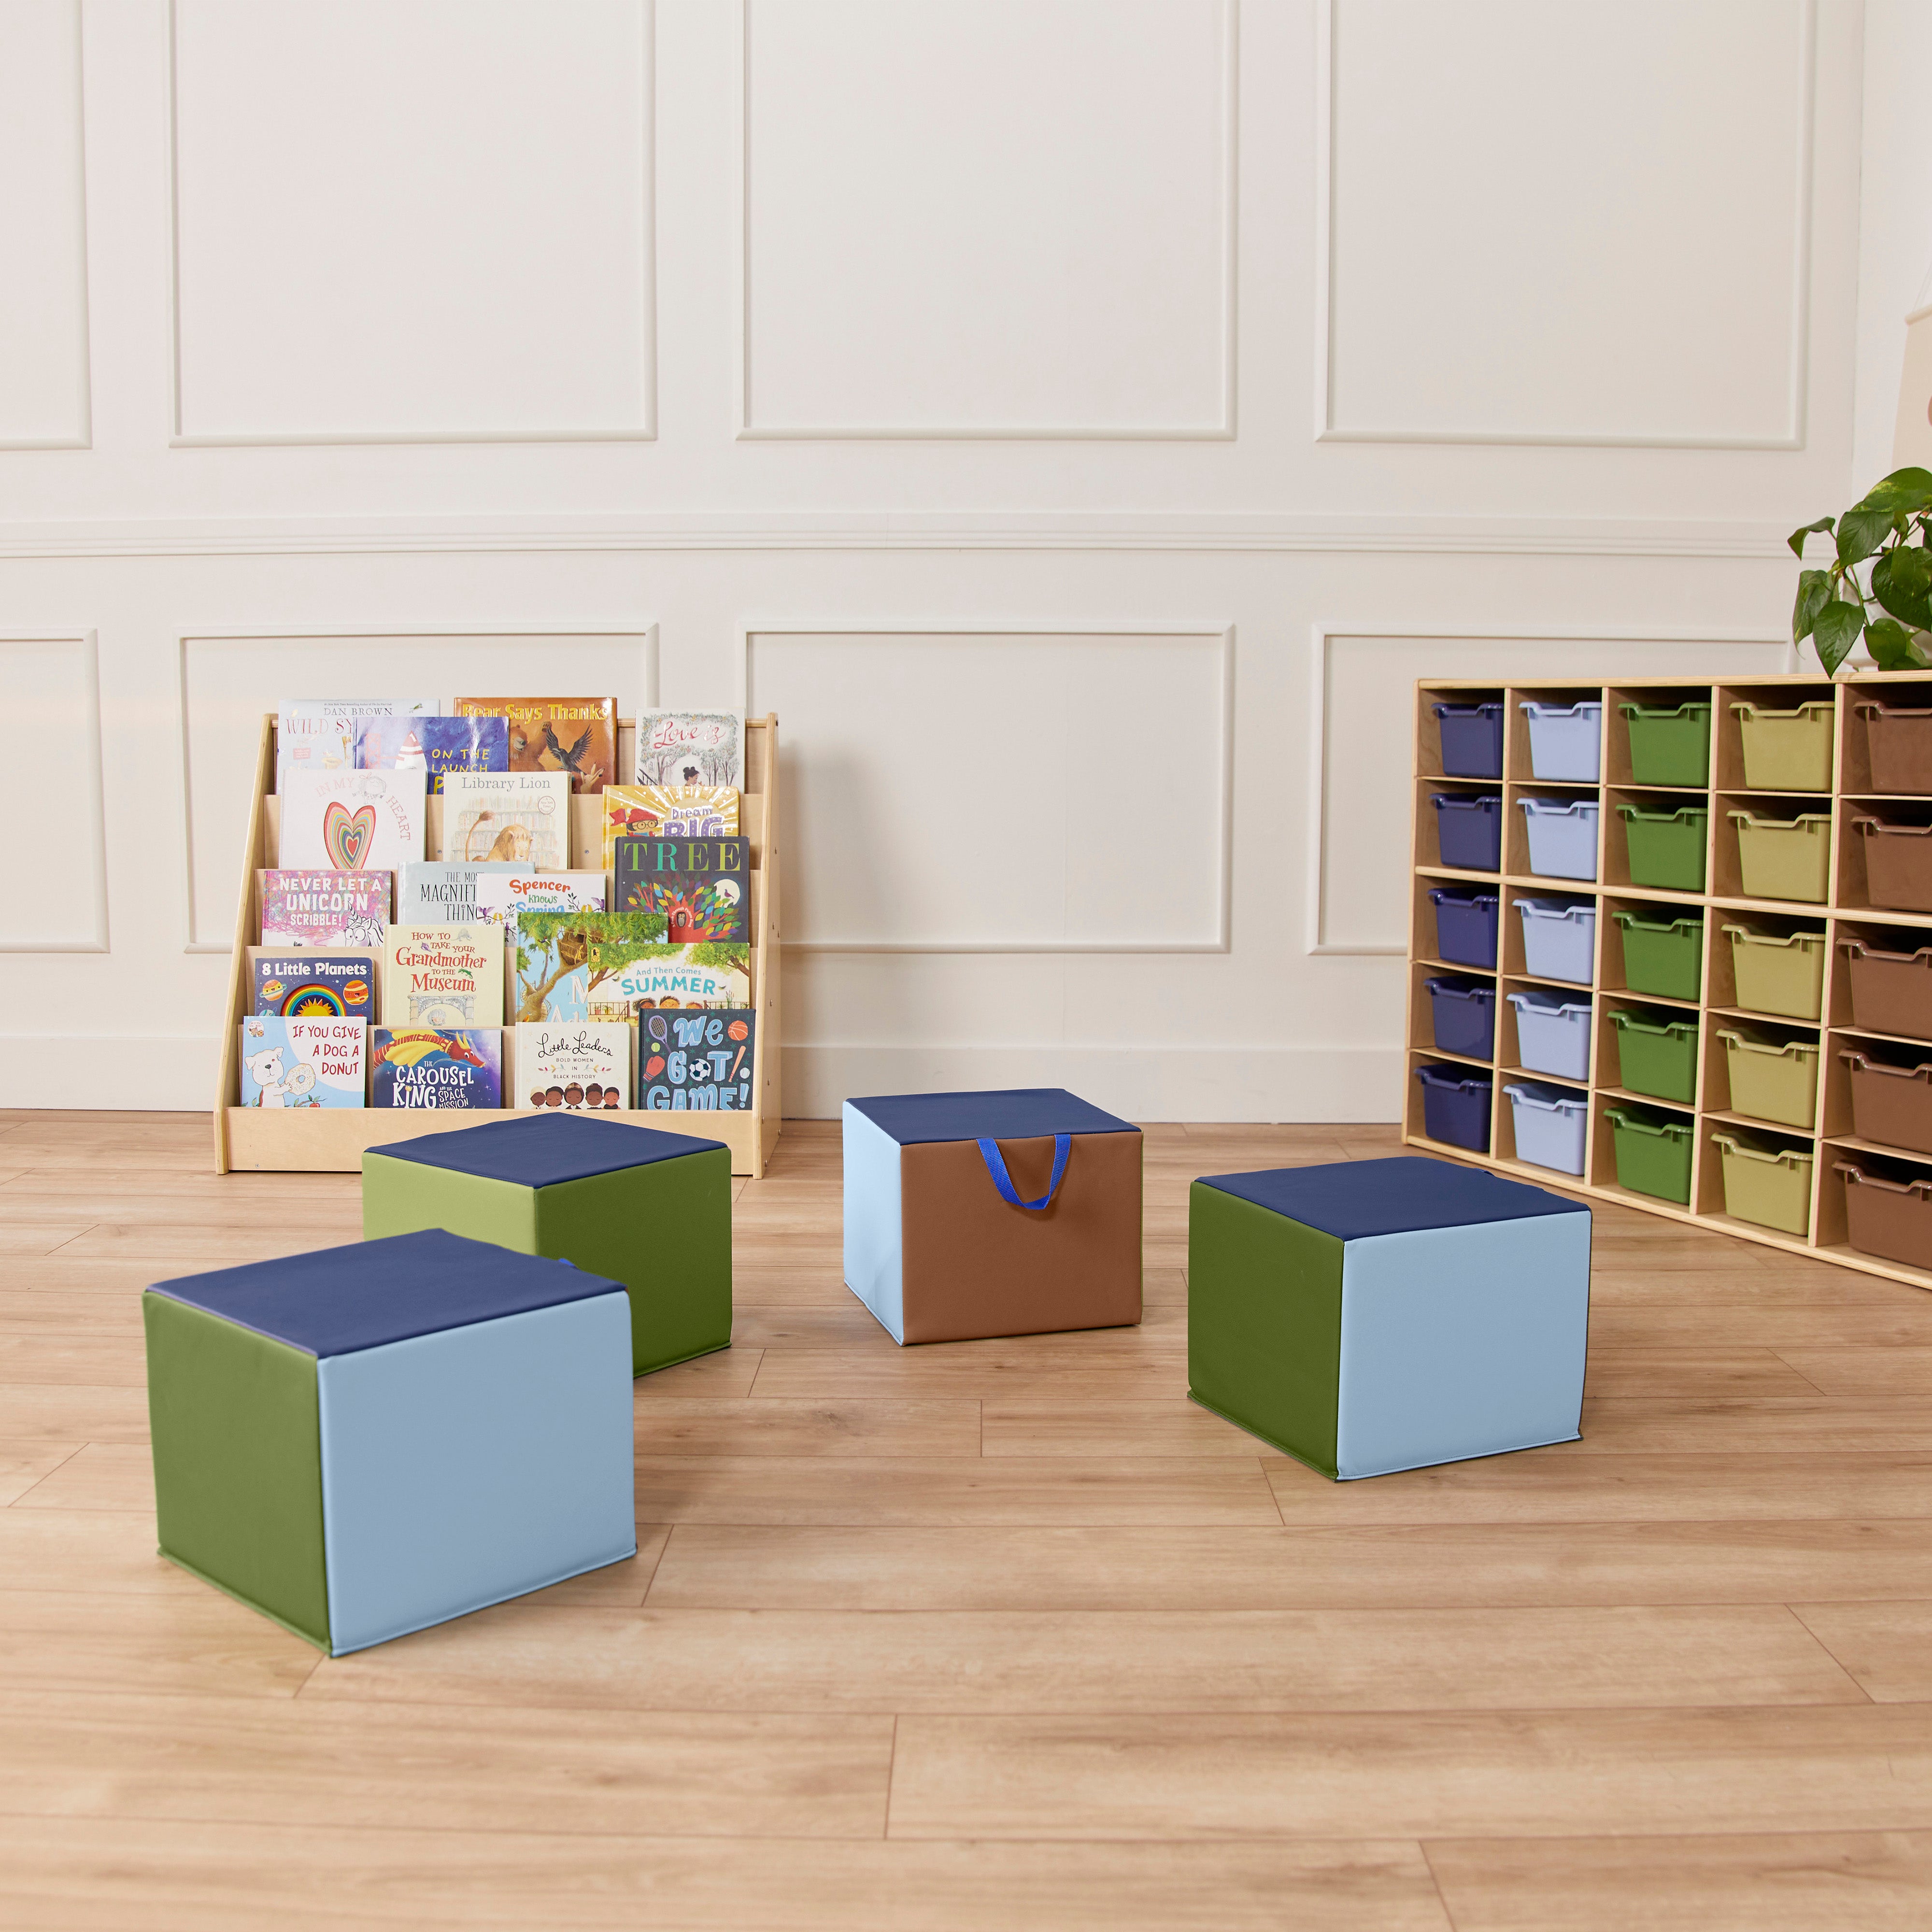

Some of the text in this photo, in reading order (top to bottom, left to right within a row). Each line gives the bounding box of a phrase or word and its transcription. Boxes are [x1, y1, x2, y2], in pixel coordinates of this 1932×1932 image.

[462, 703, 608, 724] Bear Says Thanks
[286, 718, 328, 734] WILD
[653, 721, 726, 749] Love is
[431, 749, 490, 760] ON THE
[431, 764, 488, 773] LAUNCH
[461, 777, 551, 792] Library Lion
[314, 778, 411, 841] IN MY HEART
[672, 807, 712, 820] Dream
[664, 815, 724, 837] BIG
[624, 843, 740, 871] TREE
[280, 877, 382, 891] NEVER LET A
[445, 871, 484, 882] THE MO
[509, 879, 571, 895] Spencer
[286, 894, 368, 911] UNICORN
[291, 913, 342, 927] SCRIBBLE!
[411, 932, 434, 940] HOW
[396, 946, 487, 969] Grandmother
[262, 962, 367, 976] 8 Little Planets
[637, 967, 651, 976] And
[676, 967, 701, 975] Comes
[411, 973, 476, 993] Museum
[621, 976, 716, 996] SUMMER
[293, 1025, 361, 1040] IF YOU GIVE
[313, 1044, 359, 1057] A DOG A
[536, 1031, 613, 1058] Little Leaders
[322, 1062, 358, 1075] DONUT
[396, 1066, 474, 1086] CAROUSEL
[392, 1082, 437, 1108] KING
[438, 1088, 466, 1102] SPACE
[439, 1098, 469, 1108] MISSION
